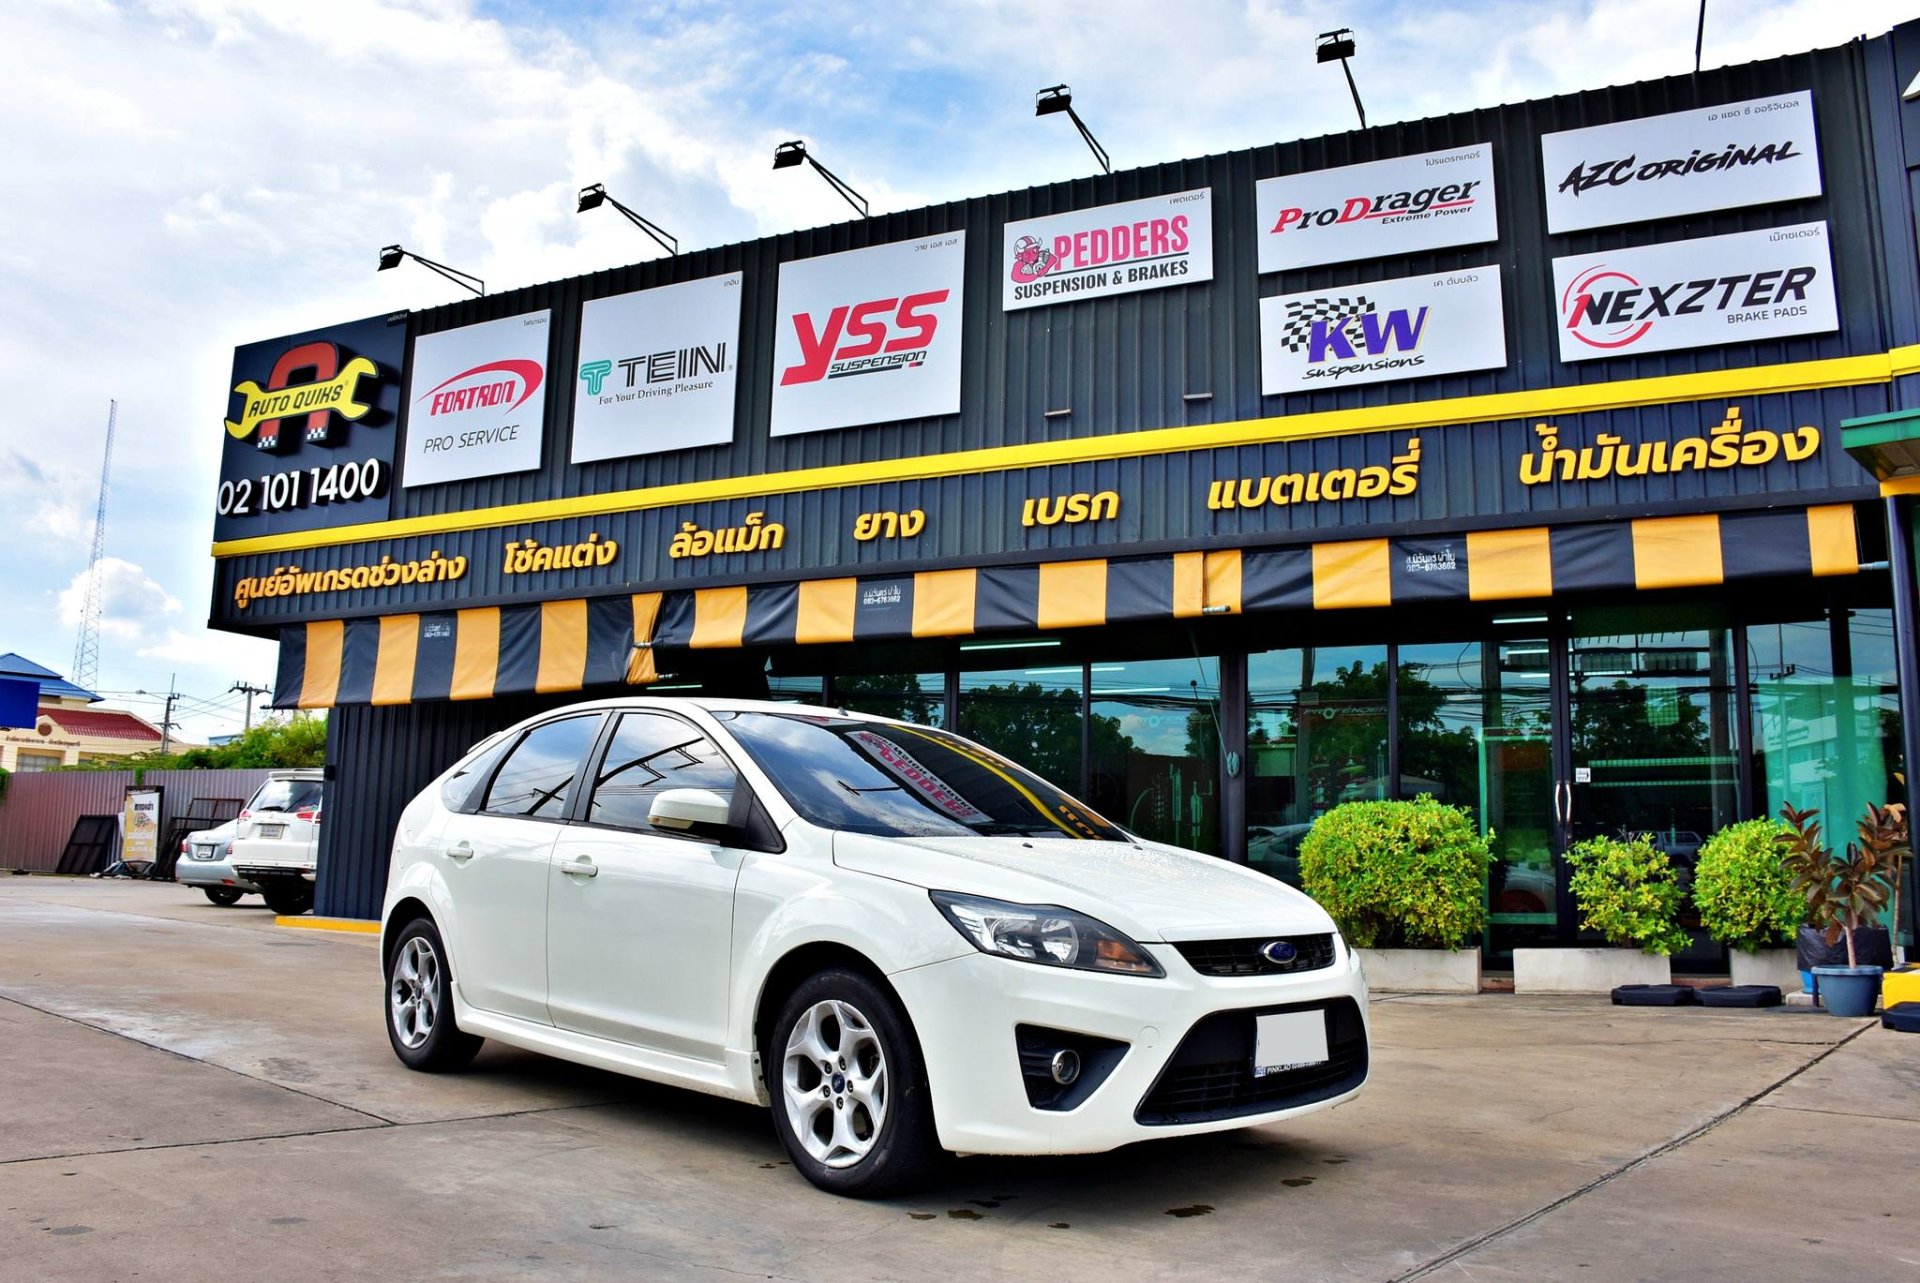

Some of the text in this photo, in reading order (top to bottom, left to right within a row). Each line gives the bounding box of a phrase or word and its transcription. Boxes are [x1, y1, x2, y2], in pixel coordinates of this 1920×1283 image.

[1270, 180, 1481, 234] ProDrager
[1382, 206, 1473, 225] Extreme Power
[1054, 214, 1189, 271] PEDDERS
[1014, 260, 1188, 300] SUSPENSION & BRAKES
[1566, 266, 1817, 329] NEXZTER
[1308, 305, 1430, 364] KW
[1727, 305, 1808, 324] BRAKE PADS
[780, 289, 950, 386] YSS
[618, 342, 726, 388] TEIN
[830, 350, 927, 374] SUSPENSION
[1302, 355, 1425, 380] suspensions
[248, 384, 344, 418] AUTO QUIKS
[431, 380, 516, 416] FORTRON
[599, 381, 714, 405] For Your Driving Pleasure
[424, 424, 520, 454] PRO SERVICE
[217, 458, 380, 515] 02 101 1400
[234, 406, 1820, 608] ศูนย์อัพเกรดช่วงล่าง โช้คแต่ง ล้อแม็ก ยาง เบรก แบตเตอรี่ น้ำมันเครื่อง
